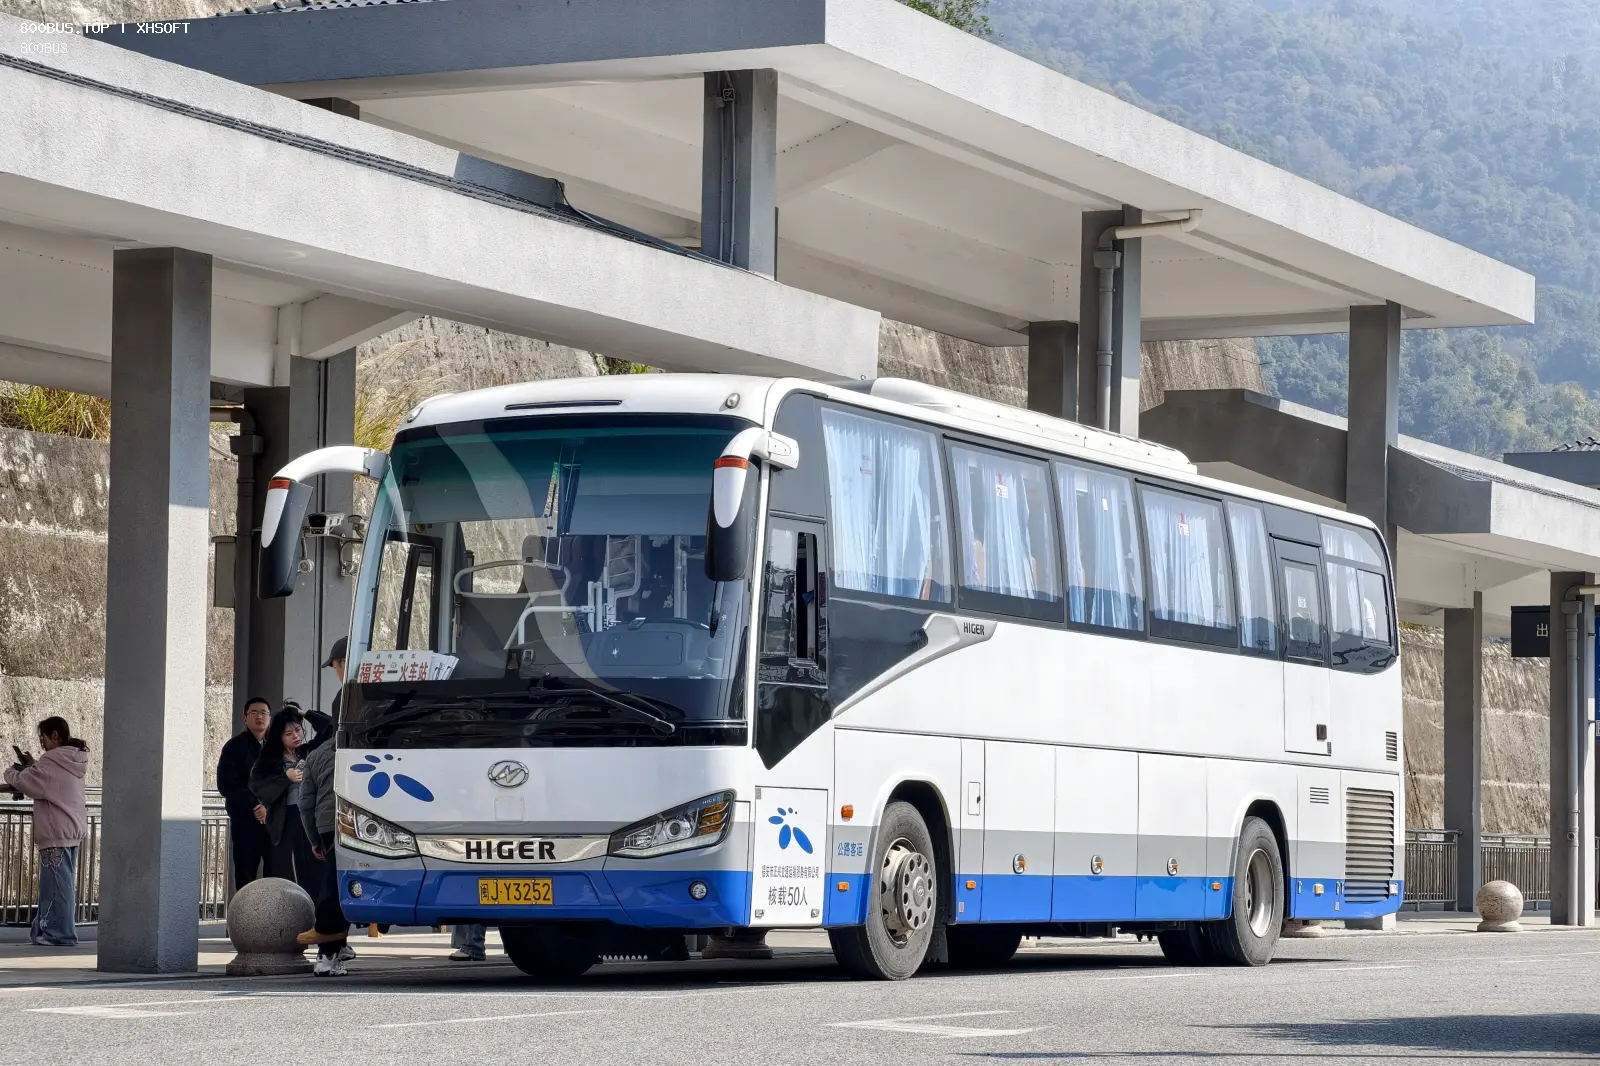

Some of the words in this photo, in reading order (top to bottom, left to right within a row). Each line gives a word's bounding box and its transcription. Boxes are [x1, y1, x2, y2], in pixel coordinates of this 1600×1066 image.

[963, 622, 985, 636] HIGER
[465, 841, 557, 860] HIGER
[837, 842, 863, 857] 公路客运
[767, 885, 808, 906] 核载50人
